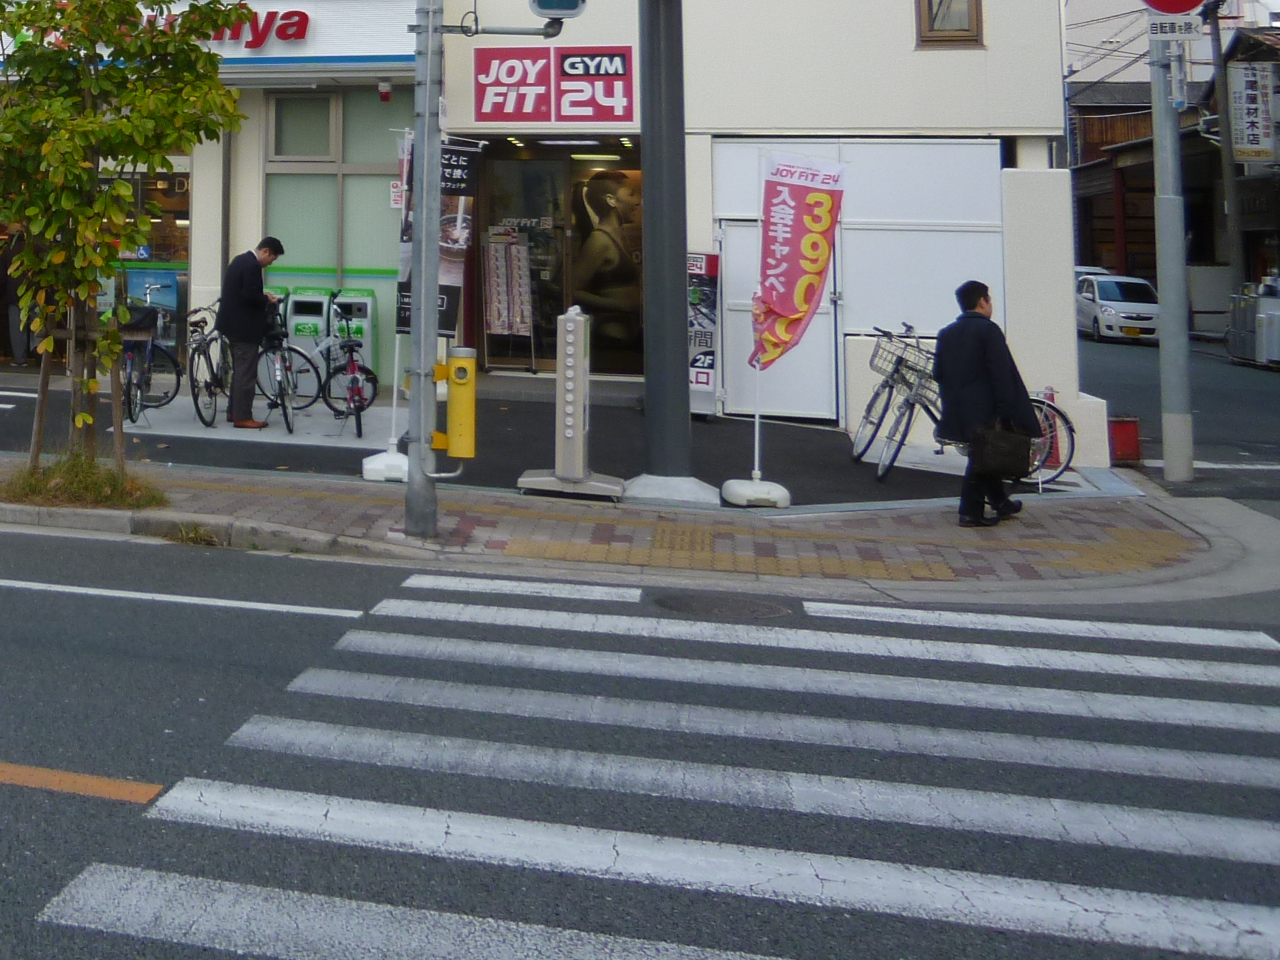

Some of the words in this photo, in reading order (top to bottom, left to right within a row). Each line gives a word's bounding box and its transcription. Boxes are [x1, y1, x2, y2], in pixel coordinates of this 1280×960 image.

[1150, 22, 1200, 34] 自転車を除く
[477, 59, 547, 85] JOY
[563, 57, 624, 75] GYM
[481, 86, 546, 113] FIT
[560, 81, 628, 116] 24
[771, 167, 797, 179] JOY
[798, 171, 819, 182] FIT
[820, 174, 840, 185] 24
[694, 355, 714, 367] 2F
[689, 371, 710, 386] 口
